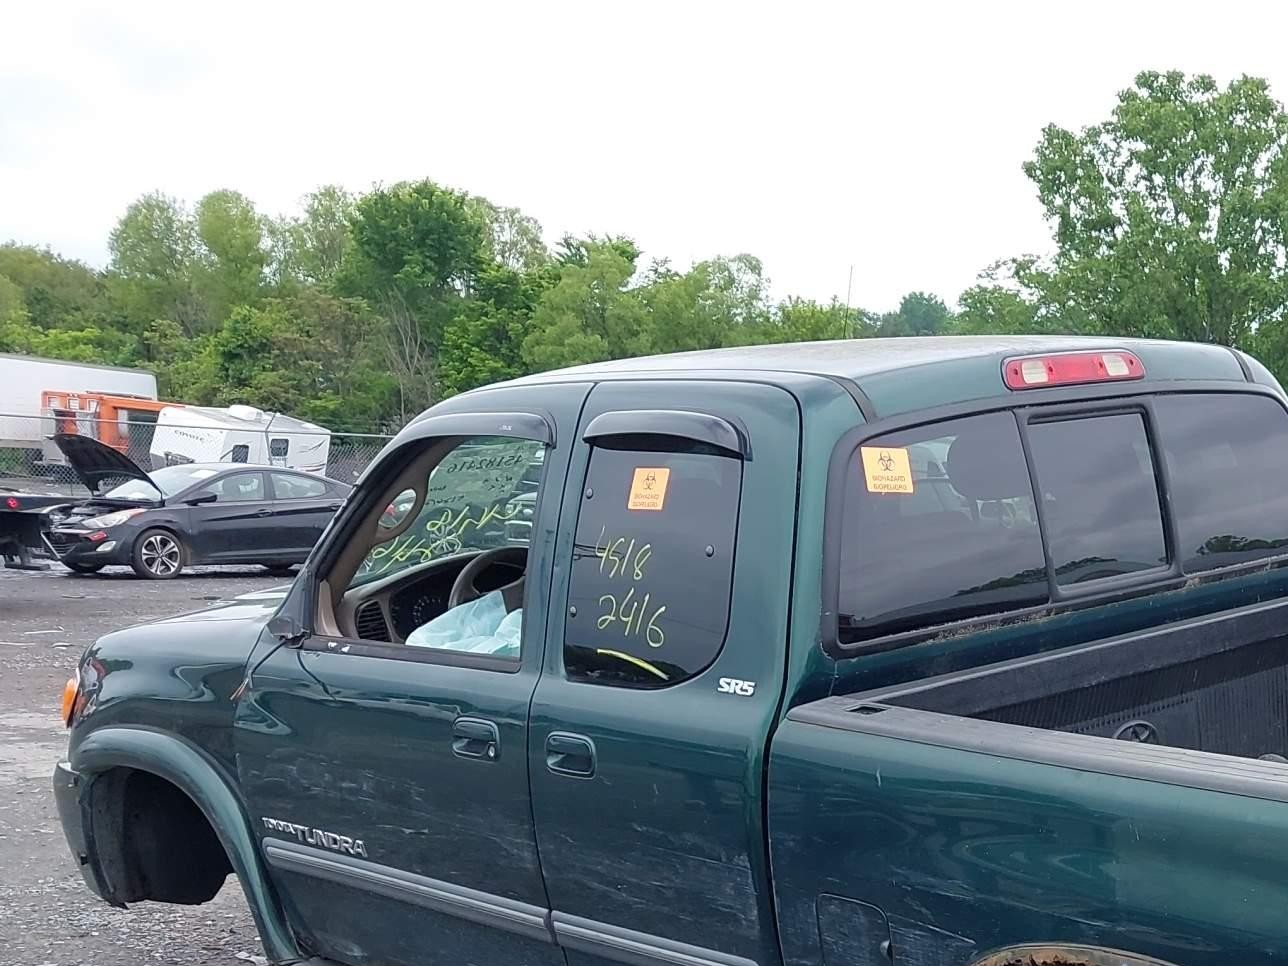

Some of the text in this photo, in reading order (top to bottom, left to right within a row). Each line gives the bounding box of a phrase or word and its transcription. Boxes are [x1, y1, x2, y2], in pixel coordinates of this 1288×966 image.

[595, 524, 652, 580] 4518
[597, 587, 667, 648] 2416
[717, 677, 756, 696] SR5
[293, 824, 368, 858] TUNDRA
